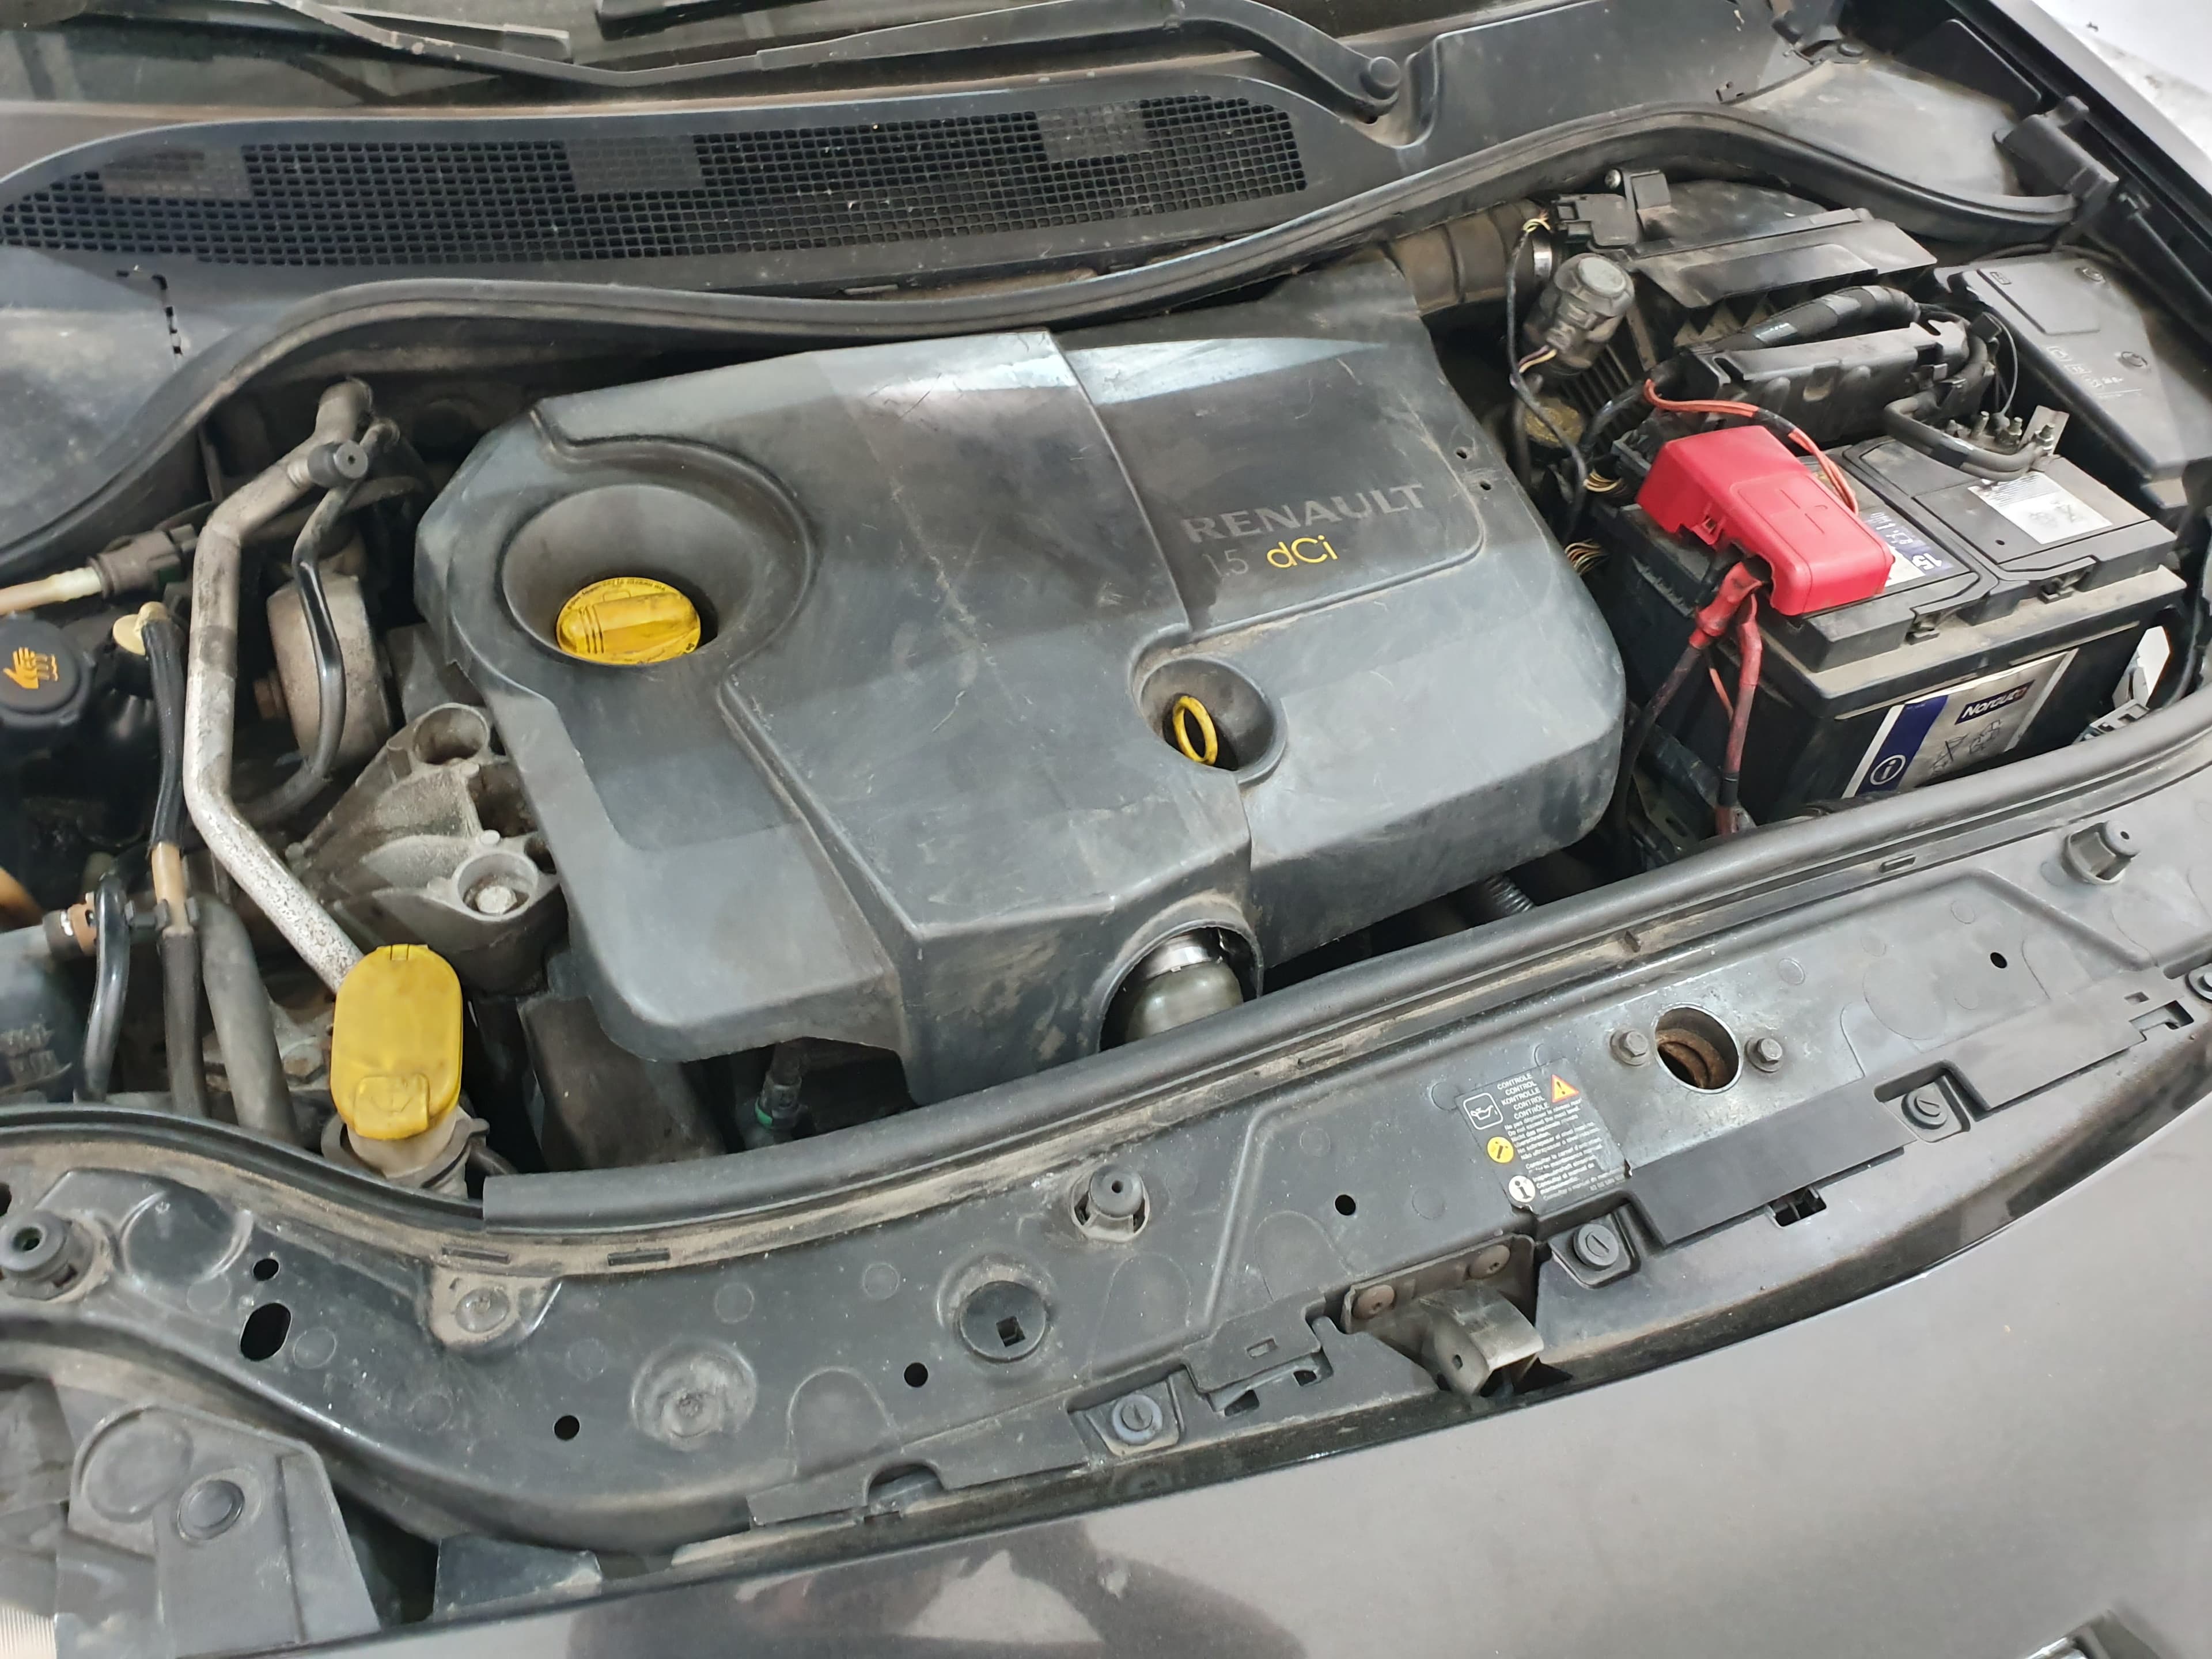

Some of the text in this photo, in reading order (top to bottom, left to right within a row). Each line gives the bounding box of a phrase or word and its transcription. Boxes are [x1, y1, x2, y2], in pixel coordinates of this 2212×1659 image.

[1180, 483, 1424, 543] RENAULT
[1203, 535, 1338, 576] 1.5 dCi
[1497, 1073, 1533, 1090] CONTROLE
[1505, 1080, 1537, 1096] CONTROL
[1501, 1088, 1541, 1105] KONTROLLE
[1513, 1096, 1546, 1111] CONTROL
